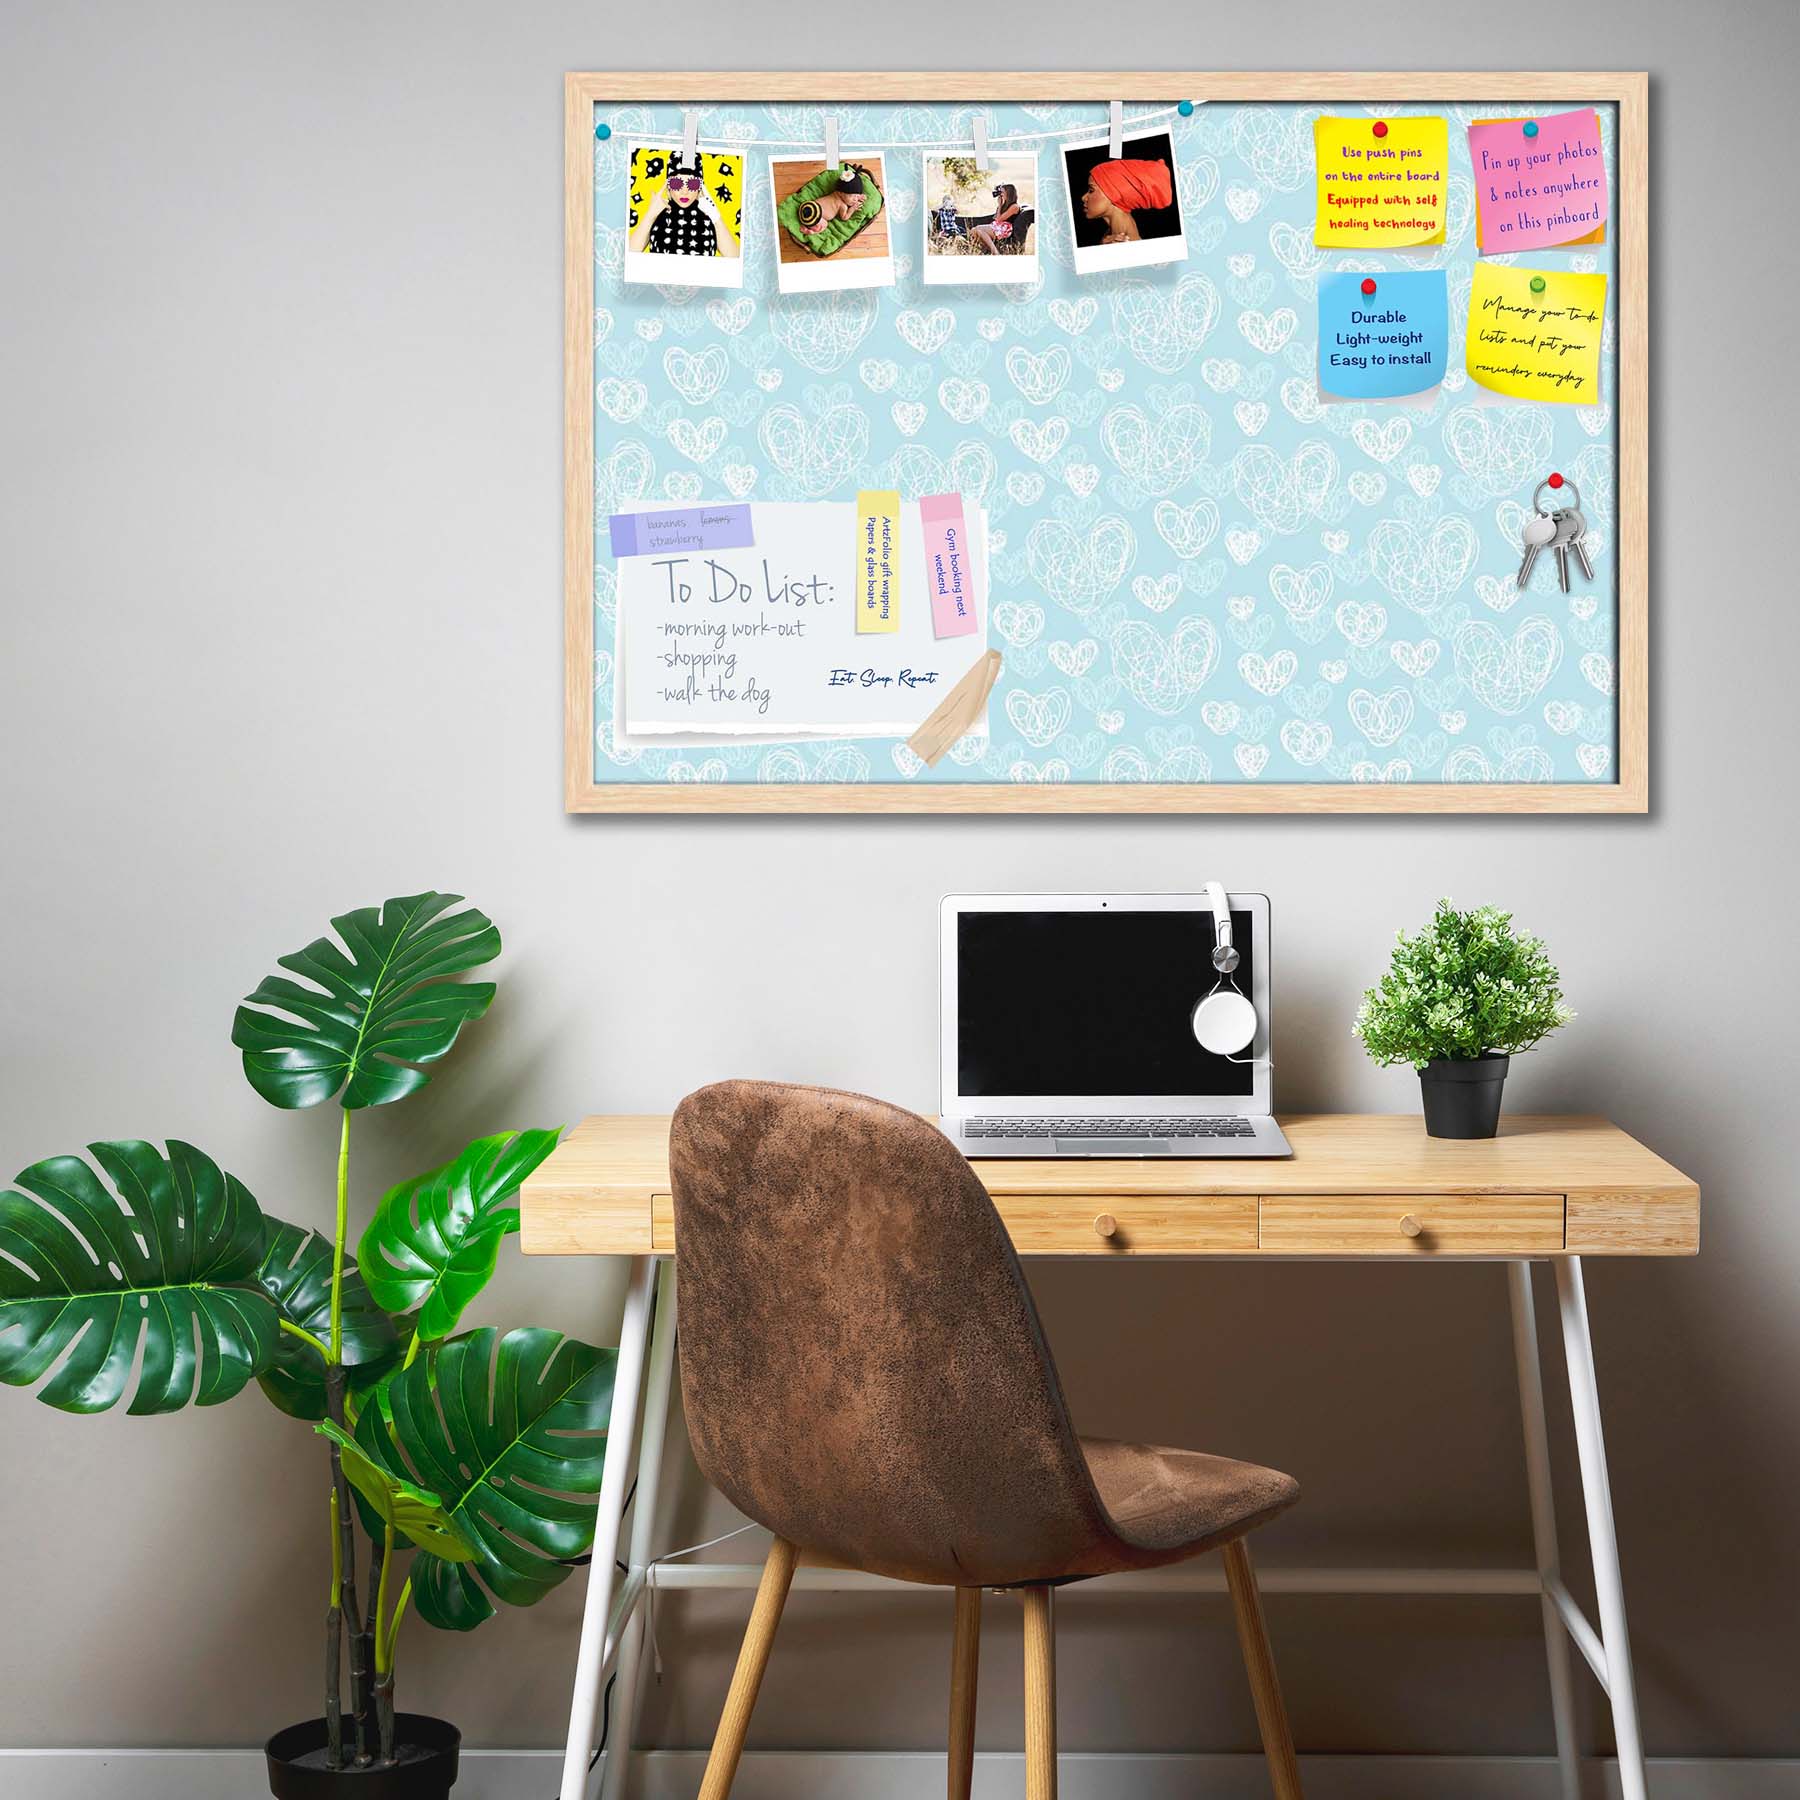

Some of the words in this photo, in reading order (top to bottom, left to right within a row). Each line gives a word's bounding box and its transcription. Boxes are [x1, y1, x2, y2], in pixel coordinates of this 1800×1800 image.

[1342, 147, 1362, 158] Use
[1366, 147, 1396, 161] push
[1400, 148, 1422, 161] pins
[1482, 151, 1501, 171] Pin
[1507, 158, 1520, 170] up
[1526, 153, 1551, 169] your
[1557, 142, 1598, 164] photos
[1325, 172, 1338, 181] on
[1342, 171, 1363, 182] the
[1367, 171, 1402, 181] entire
[1407, 170, 1440, 182] board
[1490, 187, 1499, 202] &
[1505, 183, 1537, 201] notes
[1543, 174, 1599, 197] anywhere
[1327, 193, 1379, 207] Equipped
[1384, 195, 1411, 206] with
[1416, 193, 1438, 207] self
[1329, 219, 1369, 231] healing
[1373, 219, 1436, 231] technology
[1500, 221, 1513, 233] on
[1518, 212, 1542, 229] this
[1547, 203, 1599, 231] pinboard
[1351, 310, 1407, 324] Durable
[1483, 296, 1537, 320] Manage
[1539, 308, 1565, 322] your
[1336, 332, 1424, 348] Light-weight
[1511, 335, 1536, 347] and
[1537, 337, 1563, 353] put
[1559, 344, 1586, 356] your
[1330, 353, 1367, 368] Easy
[1372, 353, 1386, 365] to
[1388, 352, 1431, 365] install
[1476, 364, 1532, 378] reminders
[1537, 371, 1584, 389] everyday
[649, 530, 703, 549] strawberry
[865, 517, 877, 545] Papers
[882, 516, 893, 560] ArtzFolio
[944, 528, 956, 551] Gym
[867, 546, 877, 555] &
[865, 557, 878, 578] glass
[880, 562, 893, 578] gift
[935, 554, 949, 595] weekend
[950, 553, 963, 594] booking
[652, 559, 691, 603] To
[704, 559, 752, 603] Do
[763, 559, 834, 607] List:
[867, 579, 877, 609] boards
[880, 579, 890, 619] wrapping
[955, 596, 967, 617] next
[732, 611, 806, 637] work-out
[708, 675, 738, 702] the
[741, 677, 771, 714] dog
